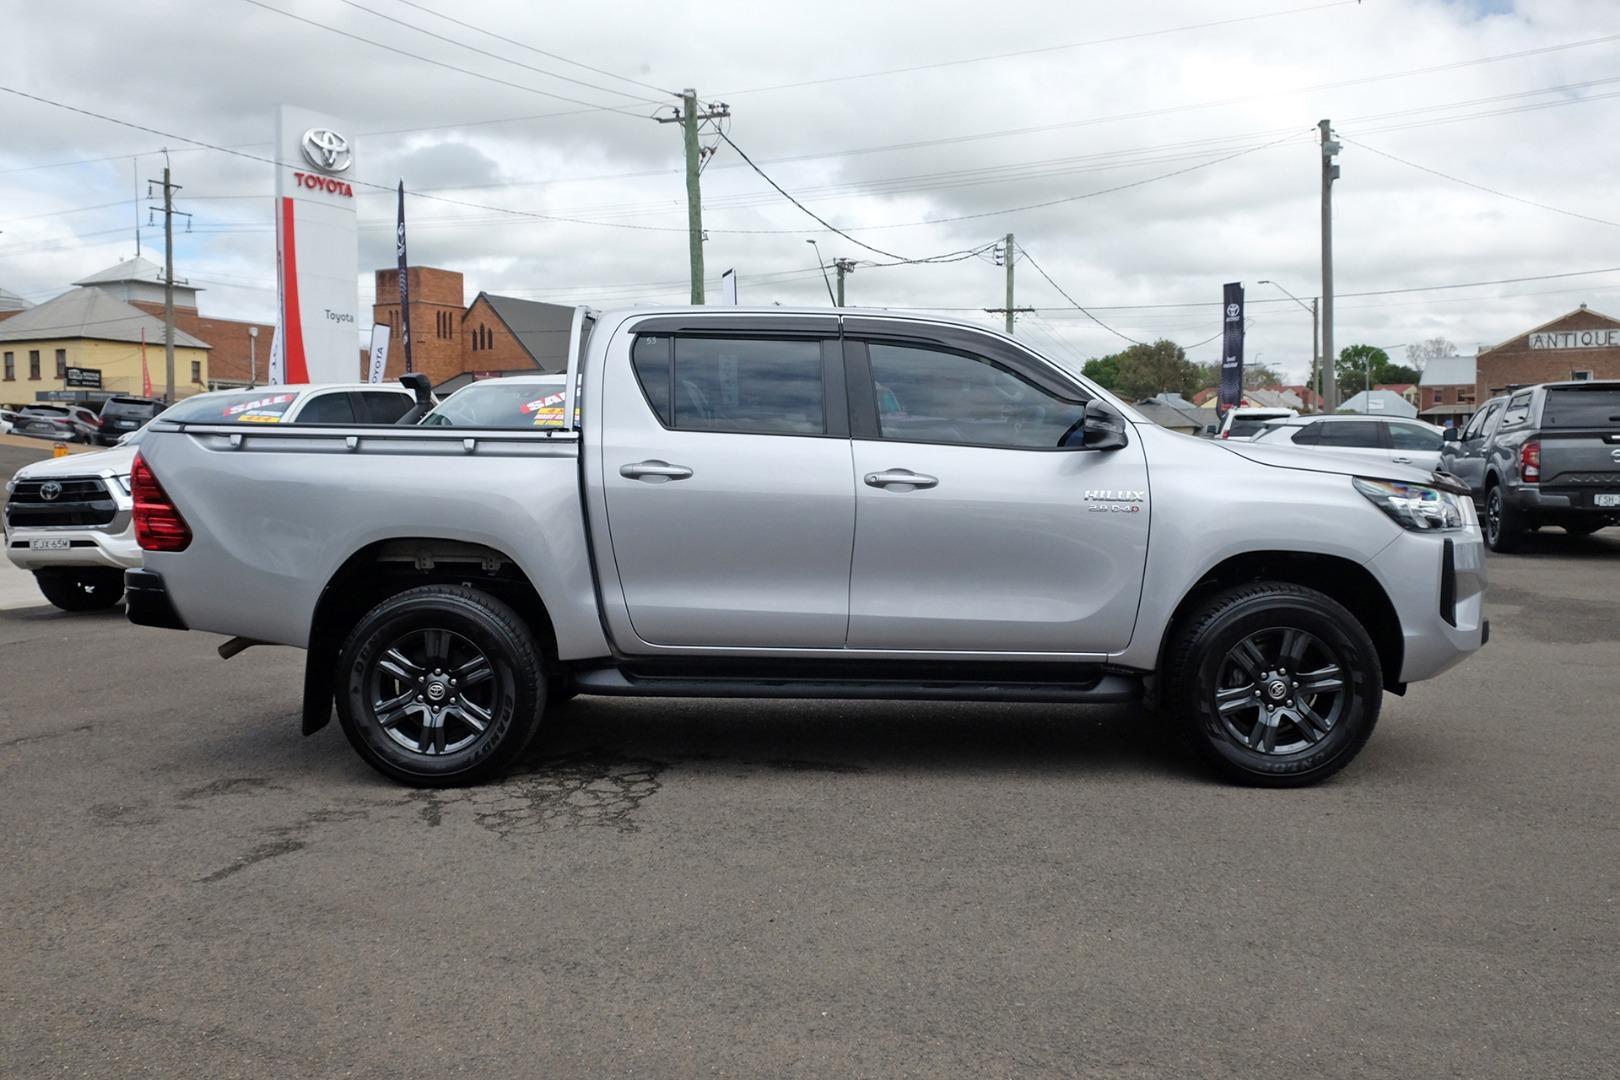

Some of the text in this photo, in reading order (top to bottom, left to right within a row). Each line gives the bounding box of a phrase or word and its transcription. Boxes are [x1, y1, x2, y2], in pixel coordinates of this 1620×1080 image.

[294, 172, 353, 198] TOYOTA
[324, 309, 355, 324] Toyota
[1533, 330, 1619, 350] ANTIQUE
[229, 394, 287, 414] SALE
[1084, 489, 1144, 503] HILUX
